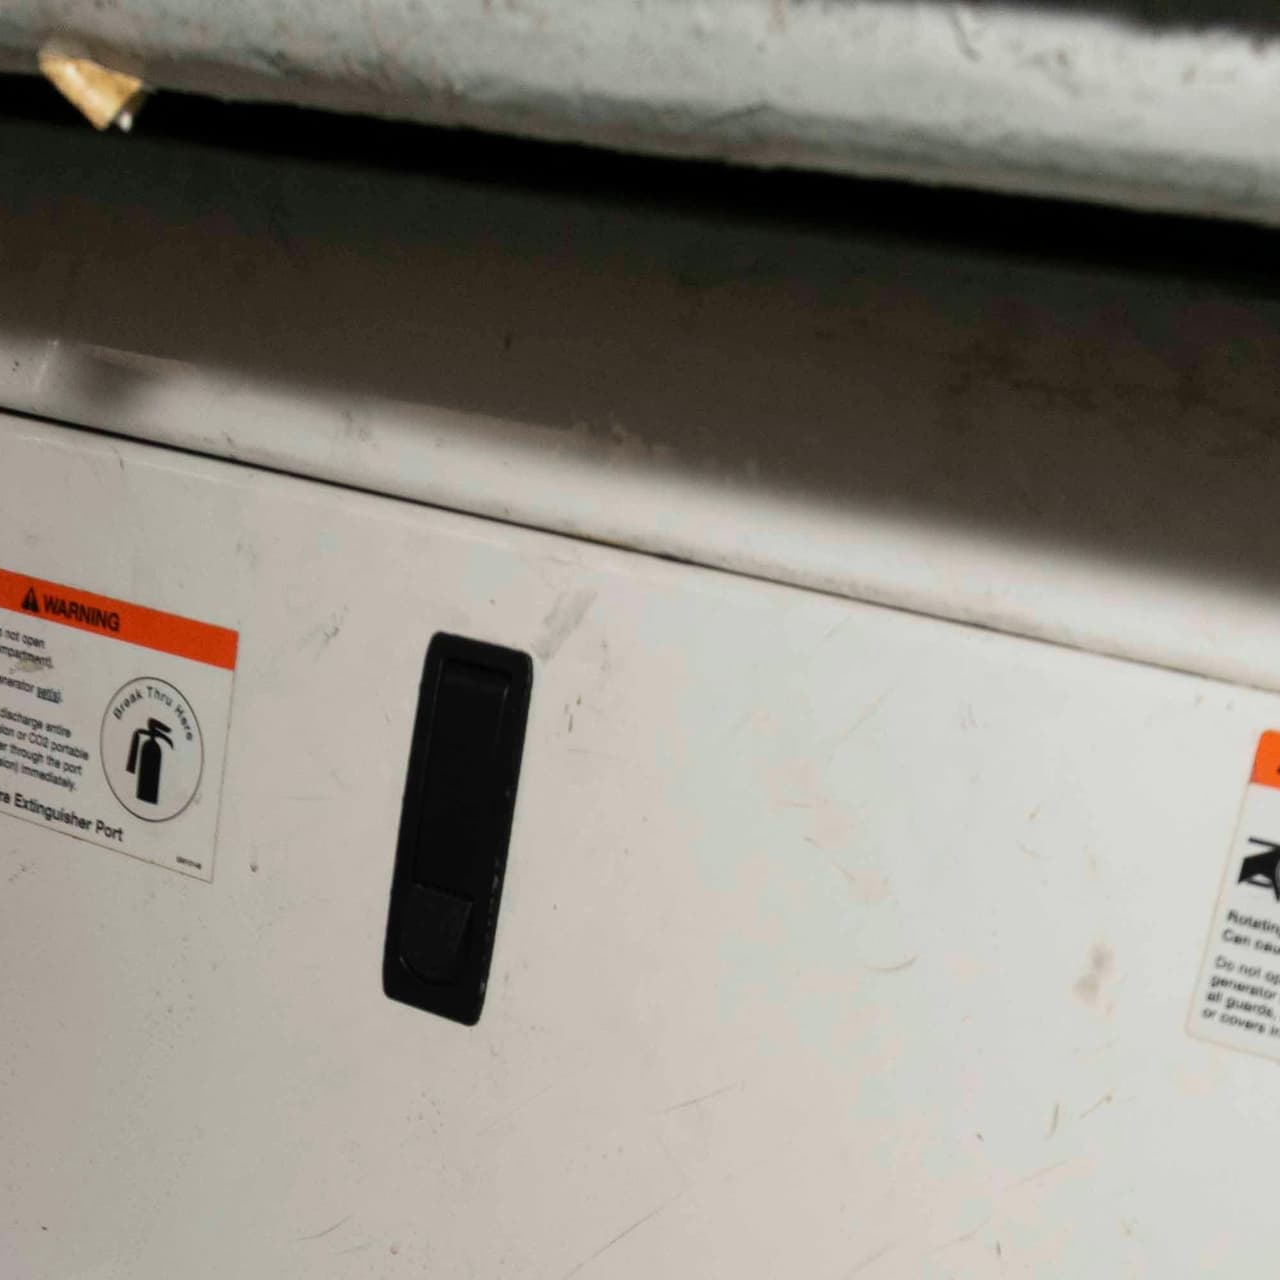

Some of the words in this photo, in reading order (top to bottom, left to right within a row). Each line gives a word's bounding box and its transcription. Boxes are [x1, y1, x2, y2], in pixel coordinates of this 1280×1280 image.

[43, 594, 120, 632] WARNING
[5, 630, 20, 642] not
[22, 634, 45, 649] open
[0, 707, 43, 730] discharge
[45, 722, 72, 738] entire
[113, 688, 142, 720] Break
[146, 686, 172, 706] Thru
[175, 704, 193, 741] Here
[16, 731, 27, 741] or
[28, 732, 49, 748] CO2
[51, 741, 89, 761] portable
[10, 744, 44, 764] through
[46, 755, 61, 769] the
[63, 761, 83, 777] port
[14, 793, 92, 831] Extinguisher
[95, 820, 124, 842] Port
[1222, 929, 1250, 947] Can
[1215, 956, 1235, 971] Do
[1239, 964, 1262, 978] not
[1207, 991, 1223, 1002] all
[1210, 975, 1277, 999] generator
[1202, 1008, 1216, 1019] or
[1220, 1012, 1266, 1033] covers
